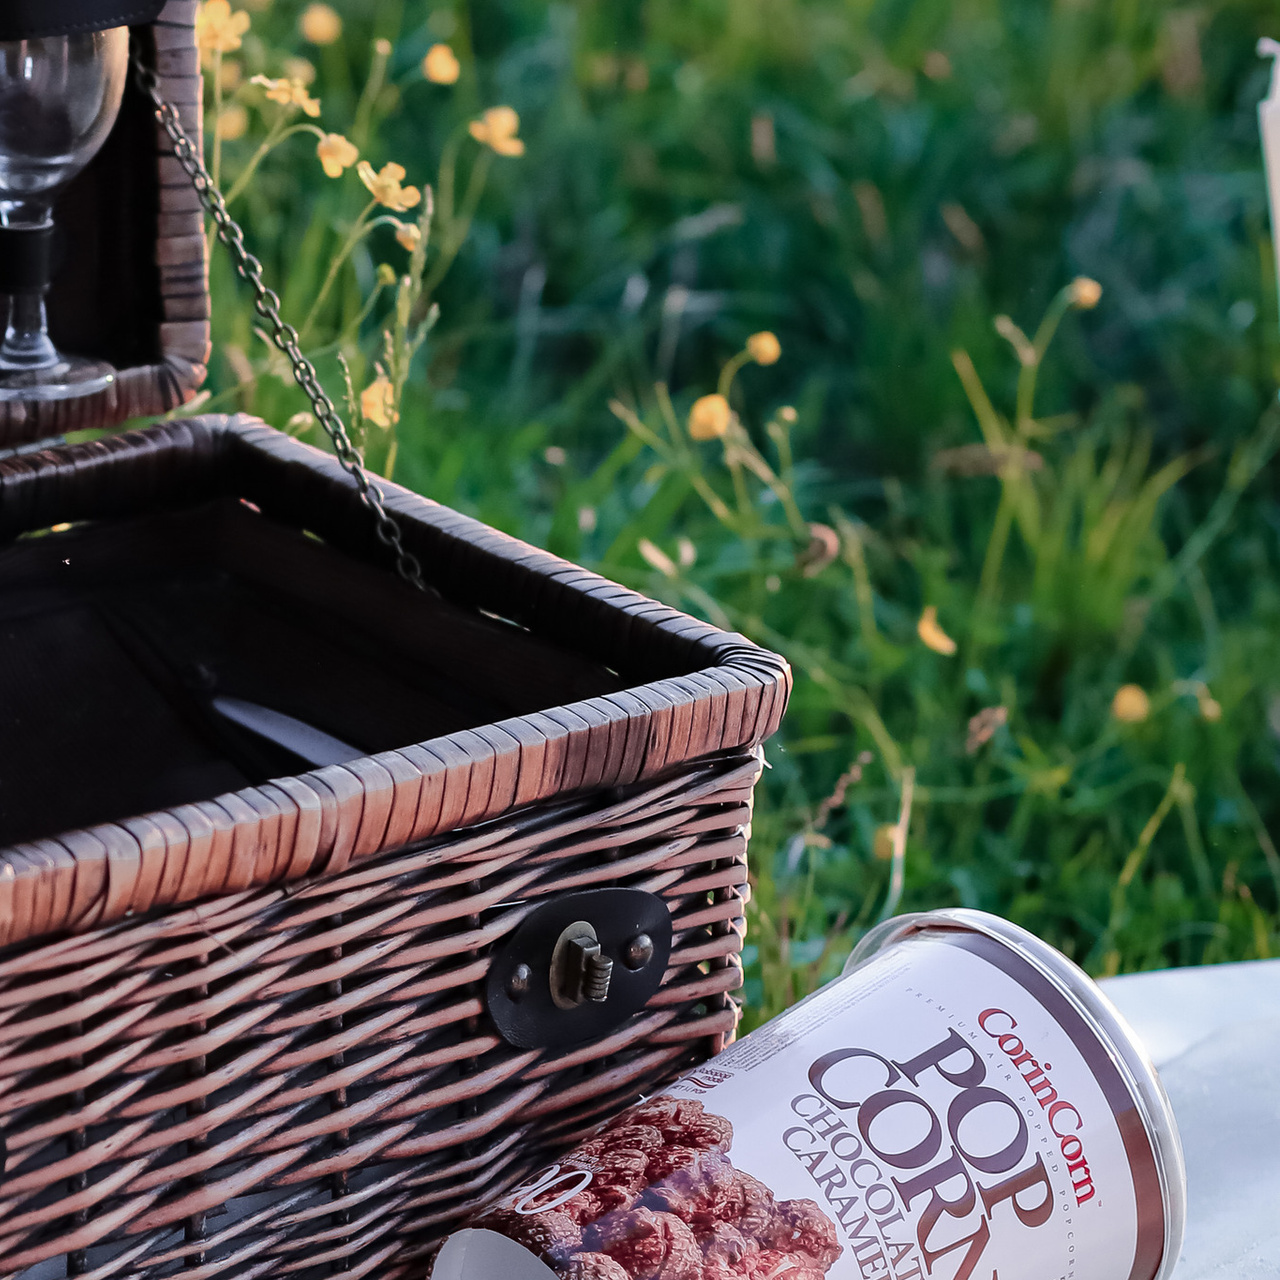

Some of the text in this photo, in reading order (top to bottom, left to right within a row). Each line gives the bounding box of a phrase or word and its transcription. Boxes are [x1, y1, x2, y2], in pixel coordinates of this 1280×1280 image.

[890, 1027, 1054, 1228] POP
[905, 987, 978, 1040] PREMIUM
[987, 1052, 1012, 1081] AIR
[1018, 1096, 1059, 1173] POPPED
[1058, 1189, 1075, 1279] POPCORN
[978, 1008, 1096, 1208] CorinCorn
